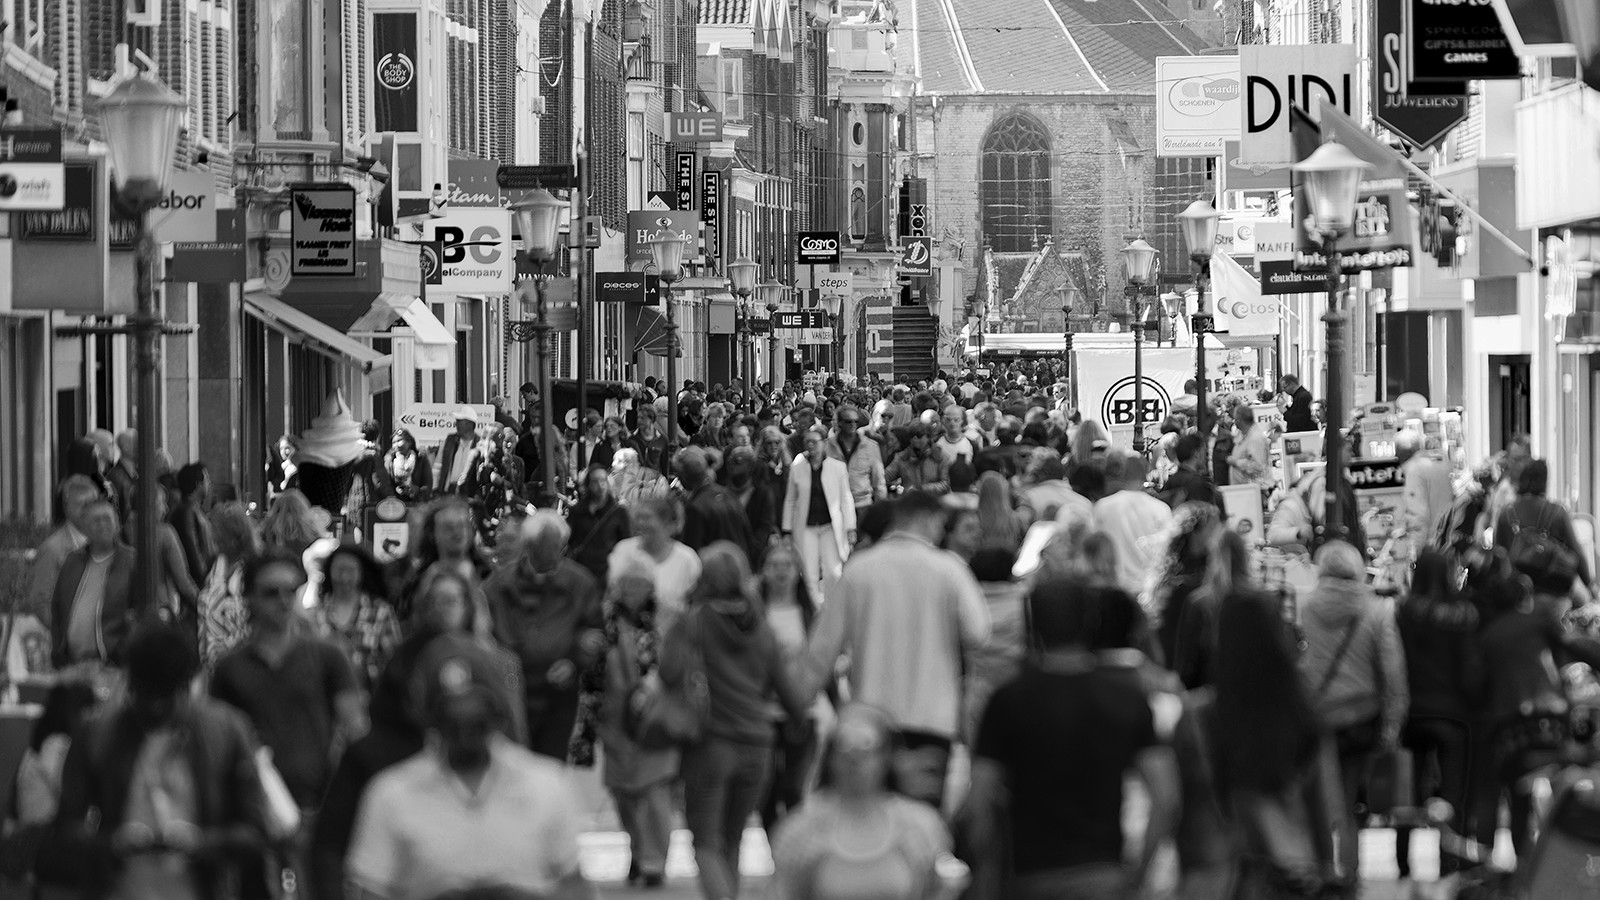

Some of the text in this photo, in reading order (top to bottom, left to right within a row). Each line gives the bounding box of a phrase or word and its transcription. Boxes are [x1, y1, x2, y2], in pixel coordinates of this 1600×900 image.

[384, 69, 407, 77] BODY
[1247, 73, 1351, 133] DIDI
[677, 118, 716, 136] WE
[681, 158, 690, 187] THE
[707, 176, 715, 204] THE
[435, 226, 502, 264] BC
[636, 229, 693, 244] Hofde
[1340, 248, 1410, 268] ntertoys
[442, 268, 502, 279] elCompany
[820, 278, 848, 289] steps
[1232, 302, 1275, 319] etos
[782, 315, 802, 326] WE
